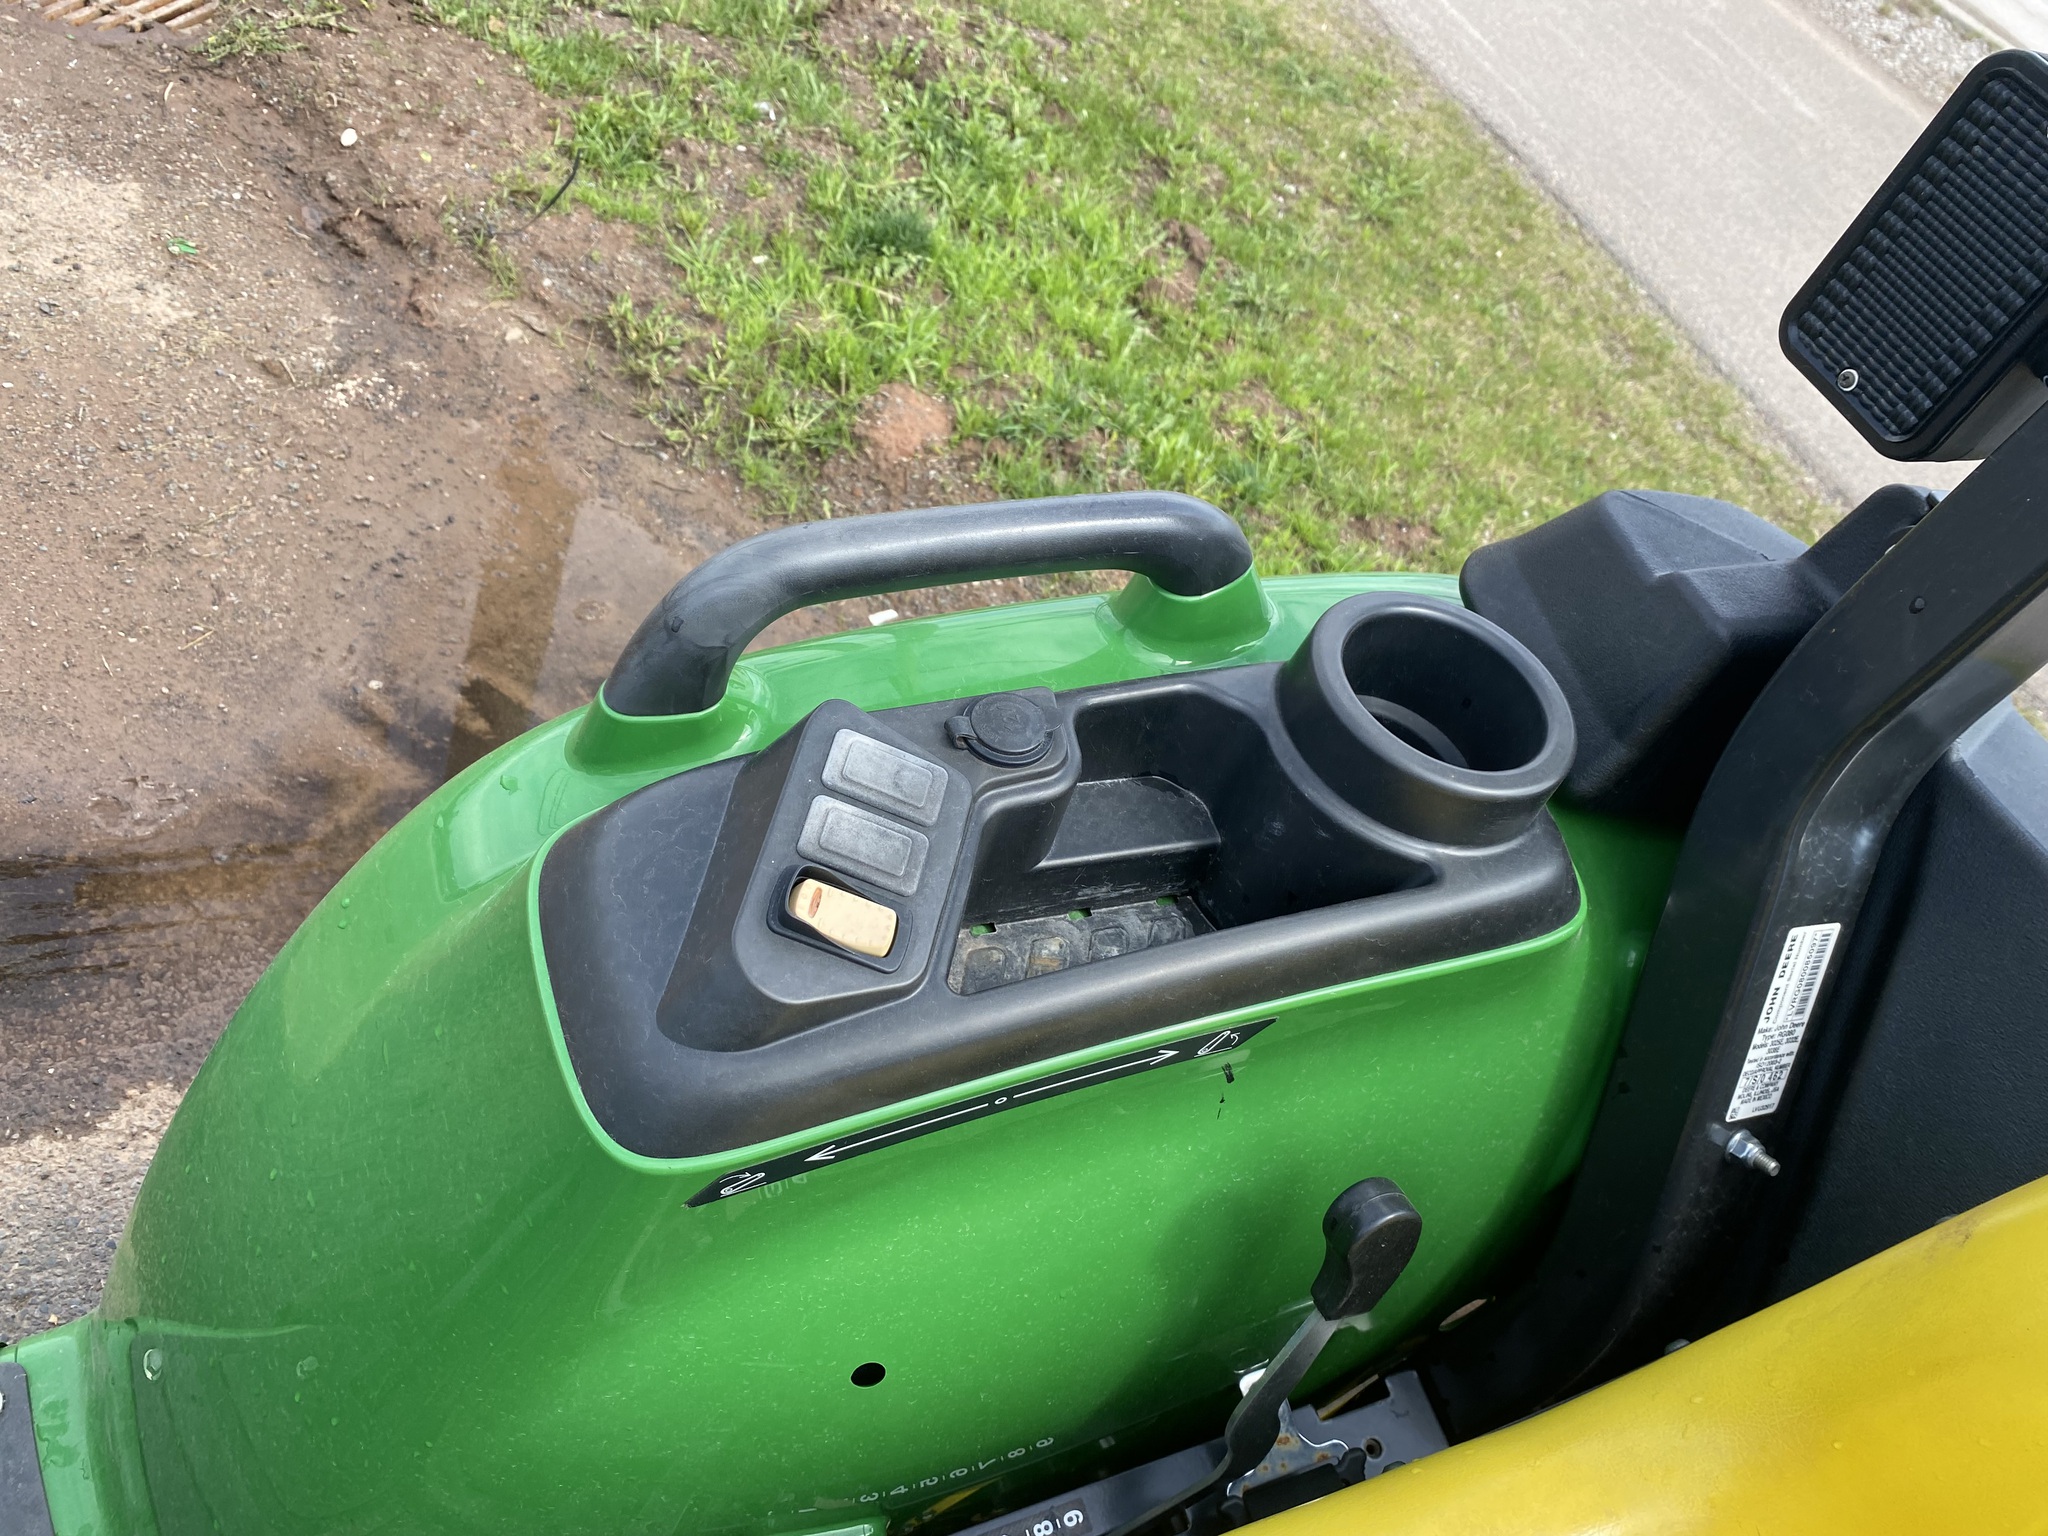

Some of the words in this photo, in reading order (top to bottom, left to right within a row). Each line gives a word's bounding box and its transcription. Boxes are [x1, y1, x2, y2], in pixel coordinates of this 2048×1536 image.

[1764, 986, 1780, 1023] JOHN
[1778, 935, 1798, 978] DEERE
[1033, 1519, 1054, 1536] 8
